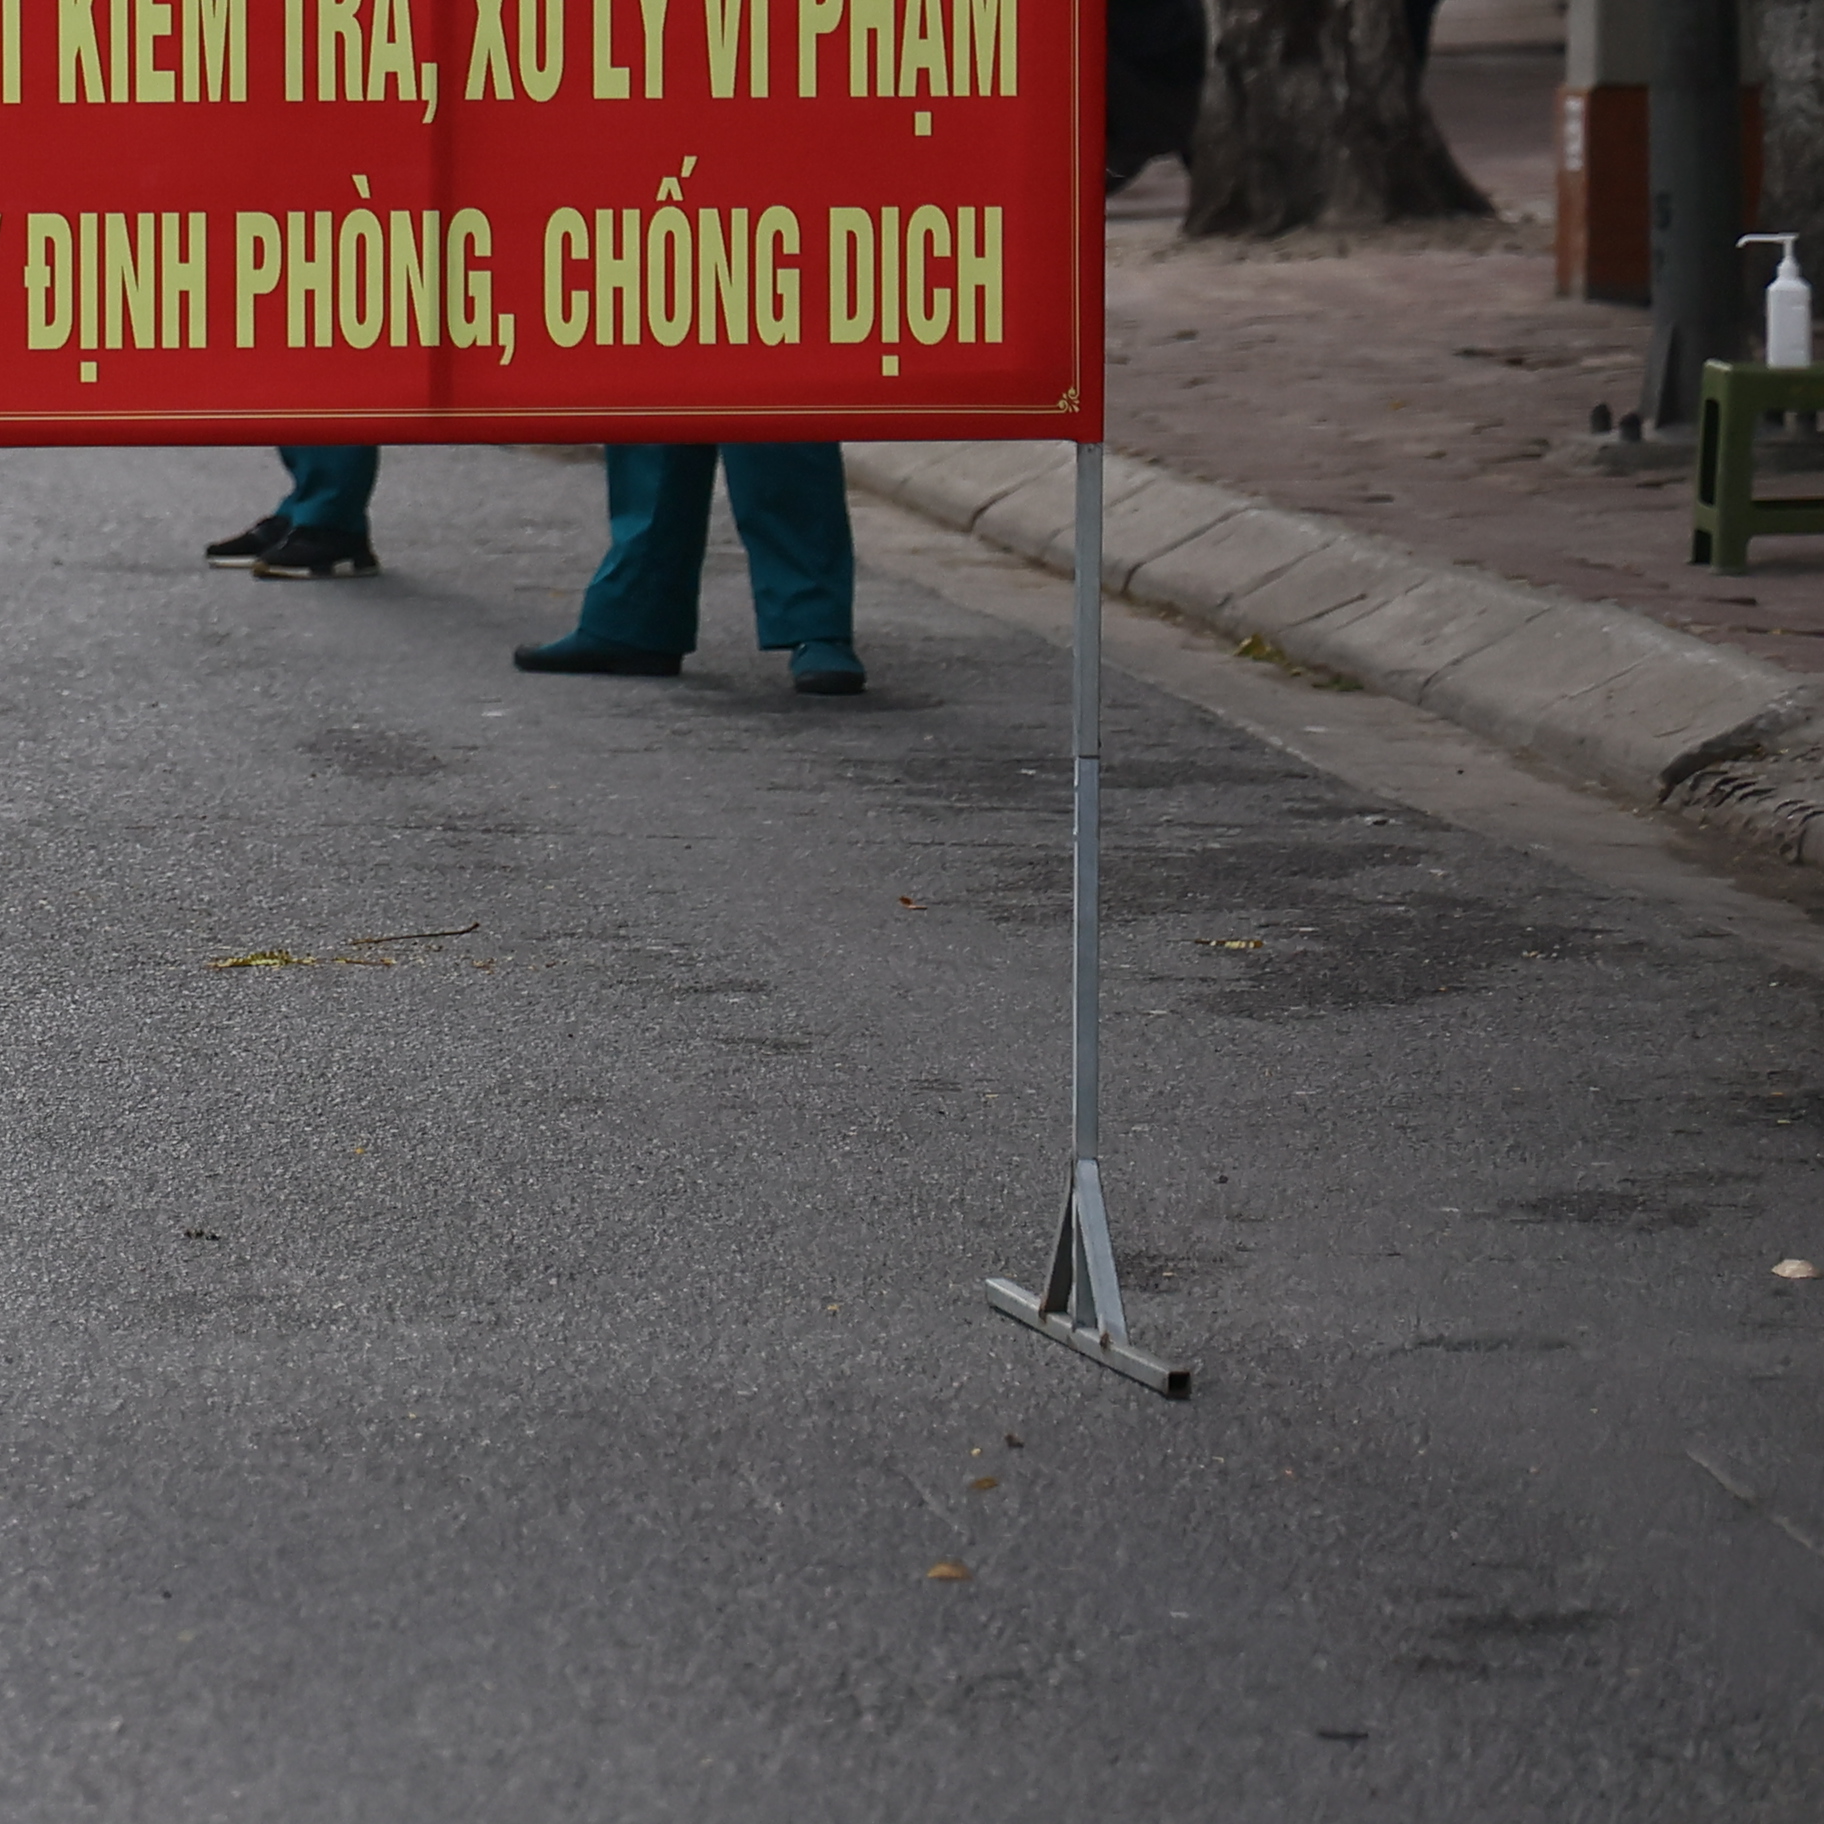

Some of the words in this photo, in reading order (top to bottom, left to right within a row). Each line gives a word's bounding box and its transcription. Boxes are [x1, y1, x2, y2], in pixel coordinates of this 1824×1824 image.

[23, 211, 207, 383] ĐỊNH
[235, 174, 515, 366] PHÒNG,
[544, 155, 801, 348] CHỐNG
[829, 204, 1003, 377] DỊCH
